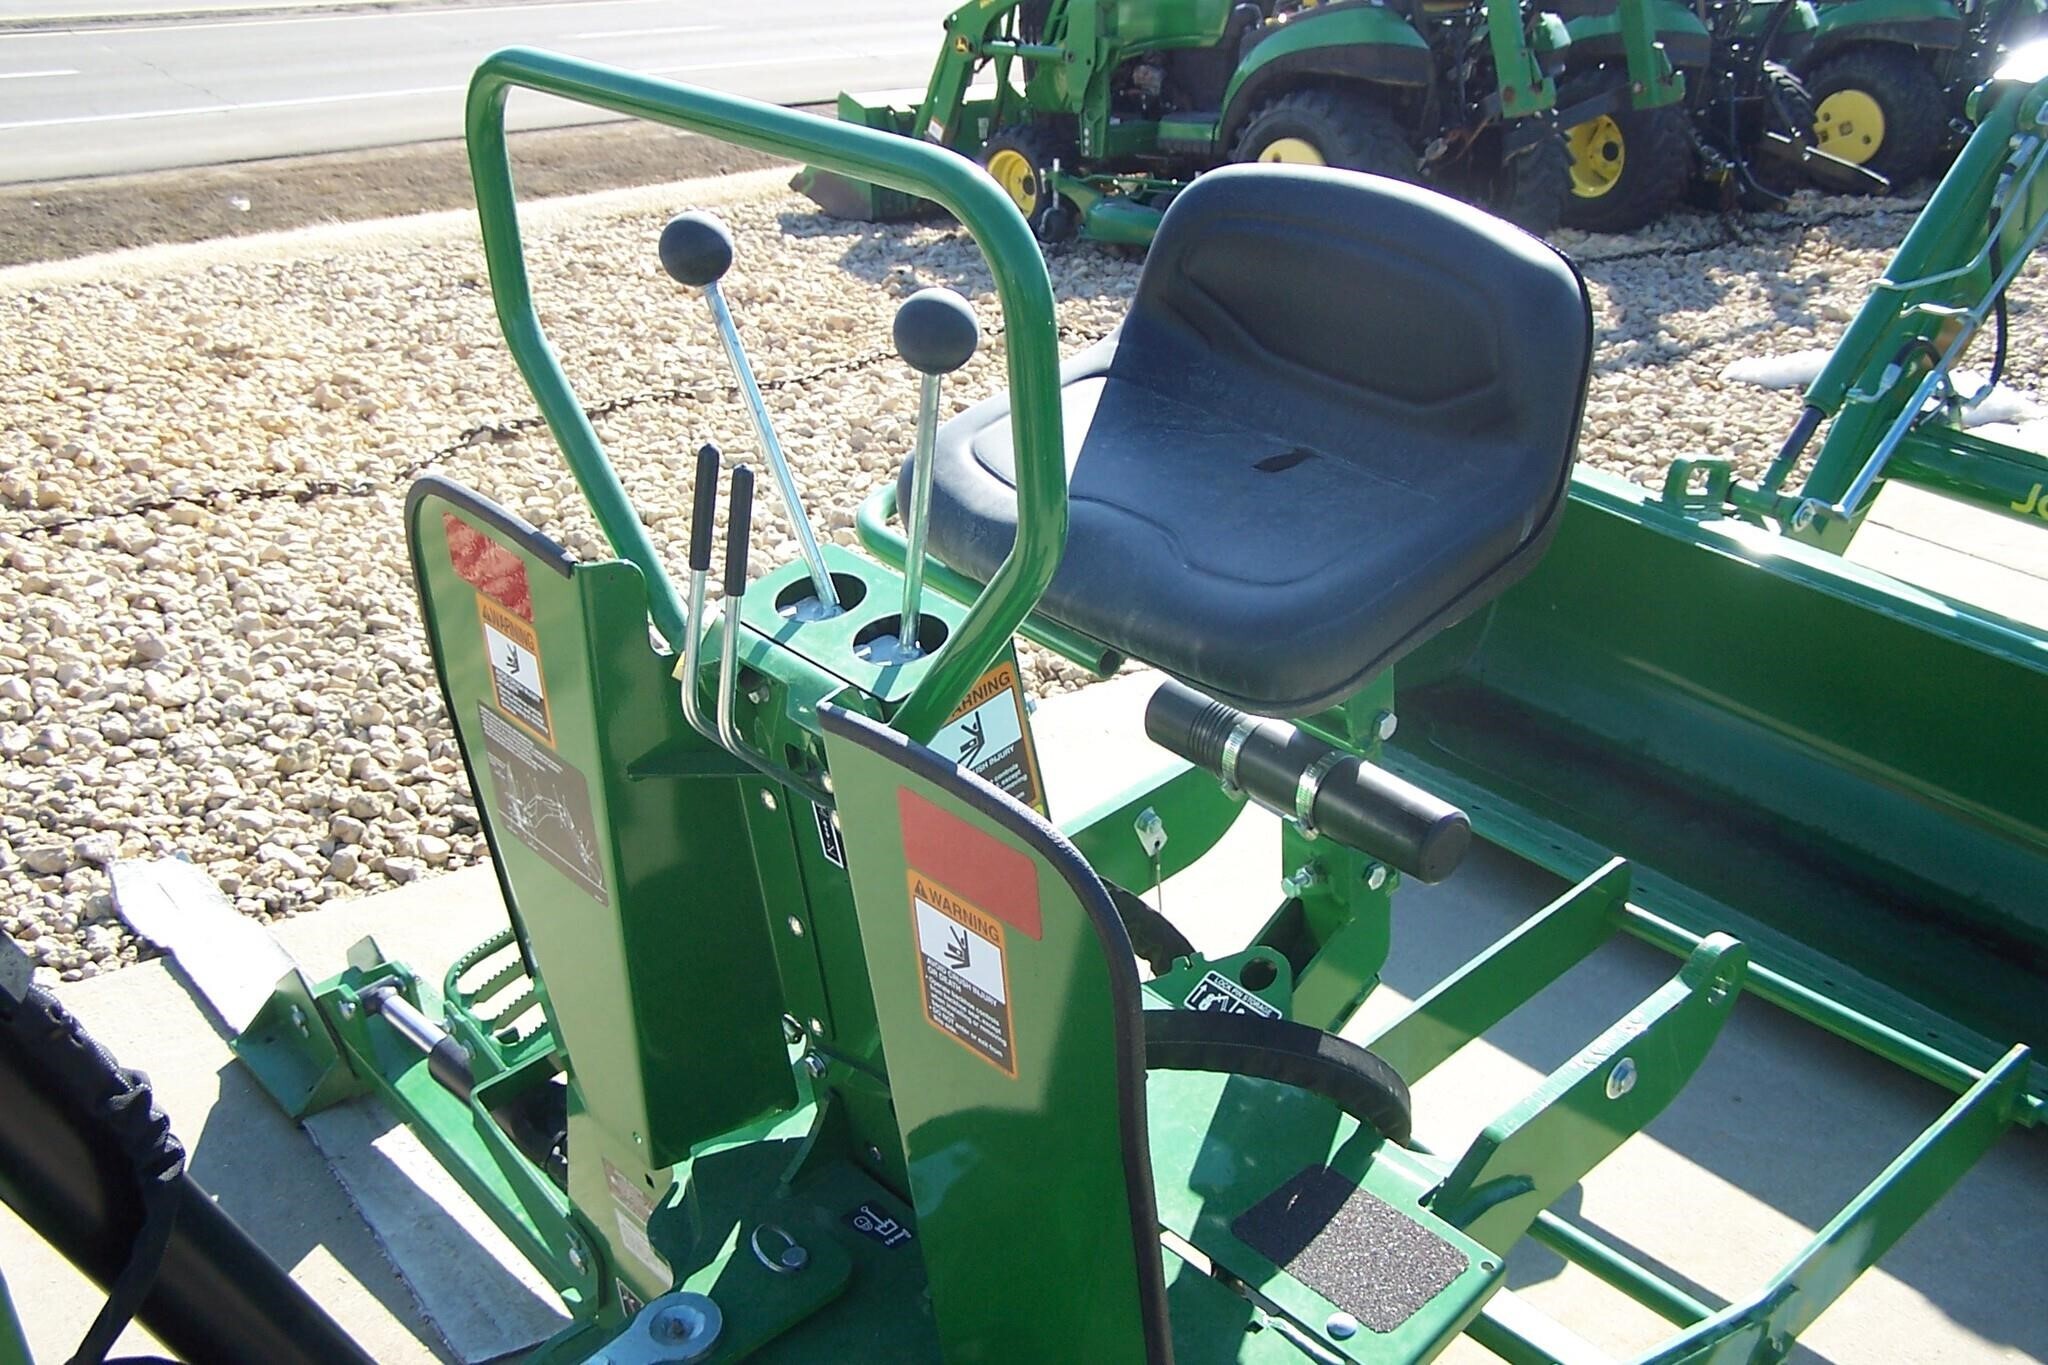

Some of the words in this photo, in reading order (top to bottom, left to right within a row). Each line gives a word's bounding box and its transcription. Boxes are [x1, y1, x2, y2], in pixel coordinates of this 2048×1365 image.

[952, 671, 1010, 717] ARNING
[989, 744, 1014, 766] INJURY
[929, 887, 1000, 941] WARNING
[938, 972, 962, 993] DEATH
[1214, 977, 1232, 991] LOCK
[1231, 988, 1244, 999] PIN
[1243, 994, 1272, 1016] STORAGE
